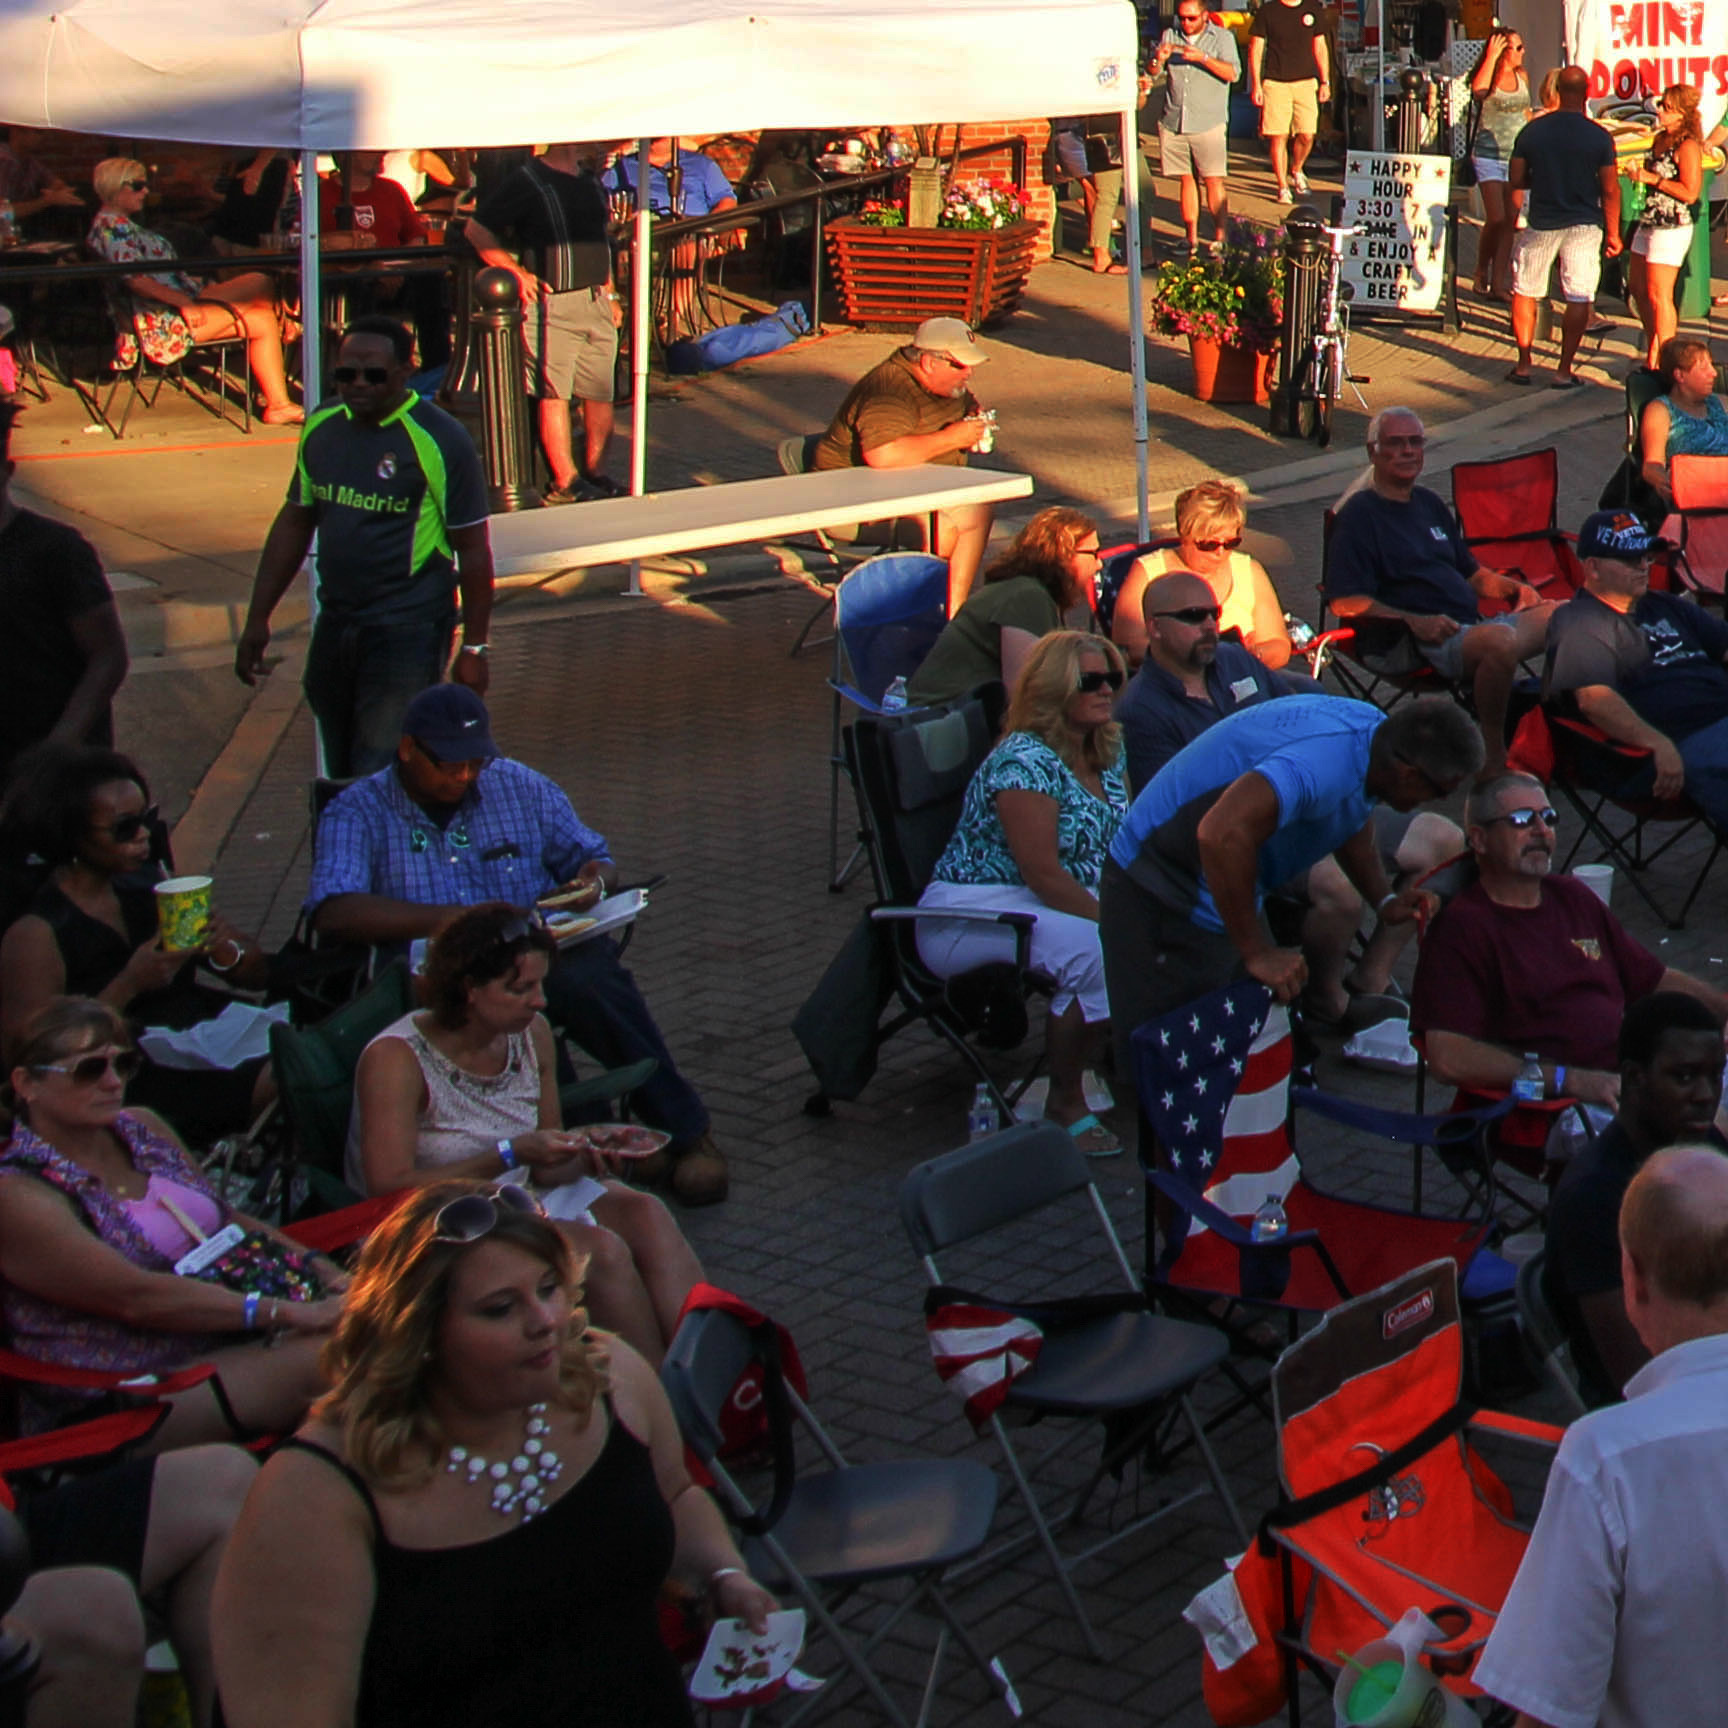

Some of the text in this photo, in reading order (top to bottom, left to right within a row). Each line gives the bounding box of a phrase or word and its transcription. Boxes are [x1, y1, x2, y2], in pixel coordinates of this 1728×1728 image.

[1609, 1, 1705, 49] MINI
[1588, 54, 1728, 100] DONUTS
[1370, 159, 1422, 177] HAPPY
[1373, 180, 1413, 198] HOUR
[1357, 199, 1393, 218] 3:30
[1411, 204, 1419, 219] 7
[1353, 220, 1428, 240] COME IN
[1351, 241, 1436, 262] & ENJOY A
[1362, 262, 1413, 281] CRAFT
[1367, 282, 1408, 300] BEER
[336, 484, 410, 513] Madrid
[1388, 1298, 1424, 1329] Coleman
